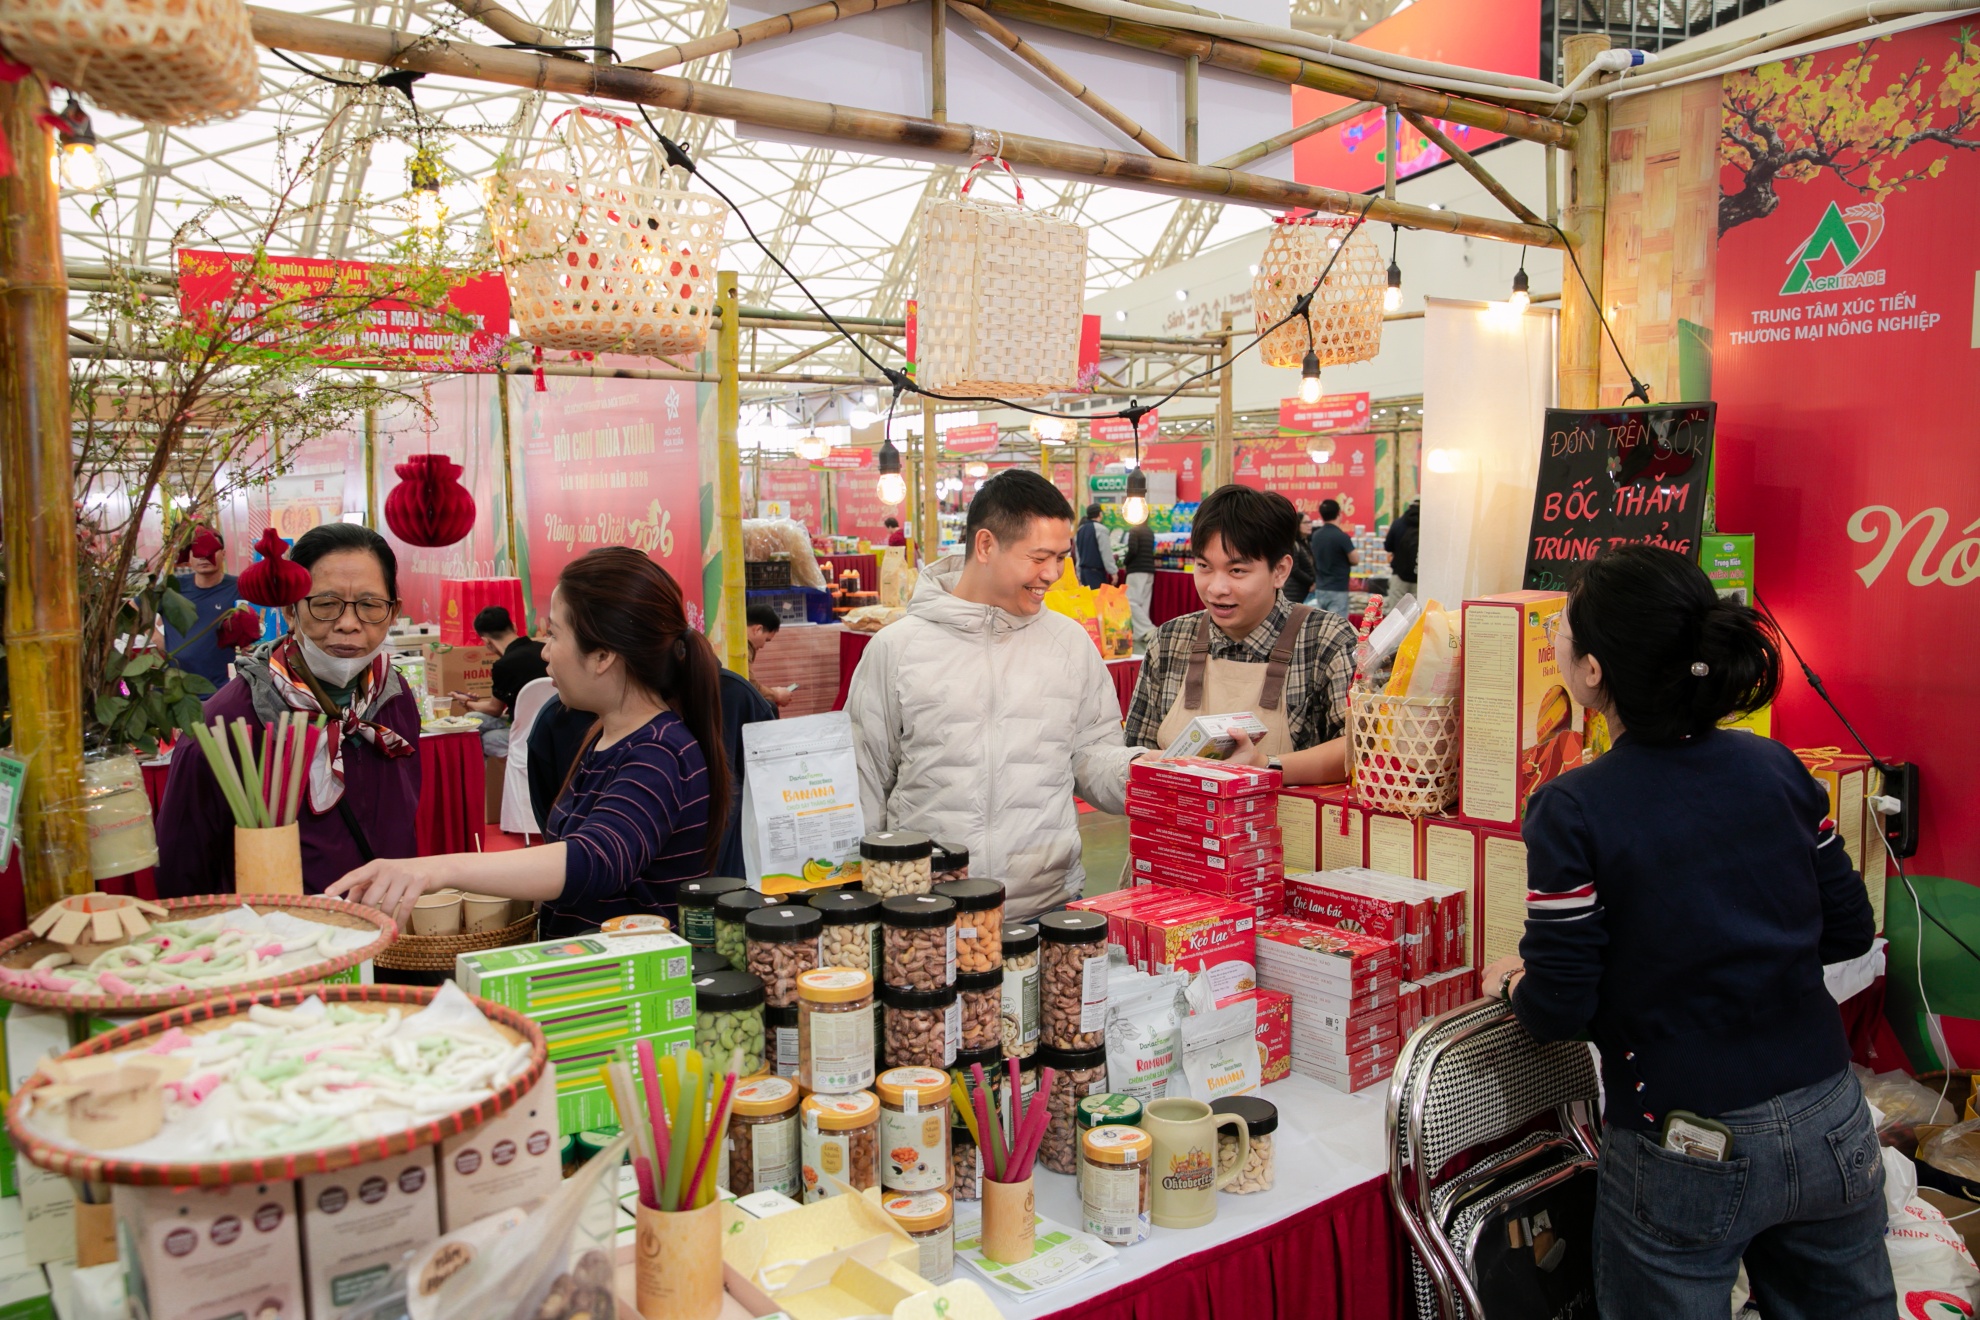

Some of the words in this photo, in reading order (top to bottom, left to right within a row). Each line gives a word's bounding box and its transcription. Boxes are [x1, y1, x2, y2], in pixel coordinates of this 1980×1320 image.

[1803, 270, 1886, 293] AGRITRADE
[1751, 308, 1801, 324] TRUNG
[1805, 302, 1837, 319] TÂM
[1842, 297, 1875, 316] XÚC
[1879, 290, 1916, 312] TIẾN
[1729, 325, 1791, 345] THƯƠNG
[1794, 322, 1824, 341] MẠI
[1827, 316, 1873, 337] NÔNG
[1877, 310, 1941, 335] NGHIỆP
[553, 428, 571, 467] HỘI
[572, 428, 594, 466] CHỢ
[595, 422, 620, 459] MÙA
[622, 417, 656, 456] XUÂN
[1551, 426, 1595, 457] ĐƠN
[1607, 419, 1651, 449] TRÊN
[629, 470, 649, 488] 2026
[1543, 477, 1600, 522] BỐC
[1615, 472, 1690, 517] THĂM
[544, 513, 577, 553] Nông
[578, 517, 598, 543] sản
[1534, 528, 1602, 561] TRÚNG
[782, 785, 835, 804] BANANA
[1293, 896, 1308, 910] Chè
[1308, 899, 1325, 914] Lam
[1326, 905, 1343, 918] Gấc
[1190, 934, 1208, 951] Kẹo
[1211, 930, 1229, 945] Lạc
[1255, 1022, 1270, 1038] ạc
[1207, 1069, 1245, 1091] BANANA
